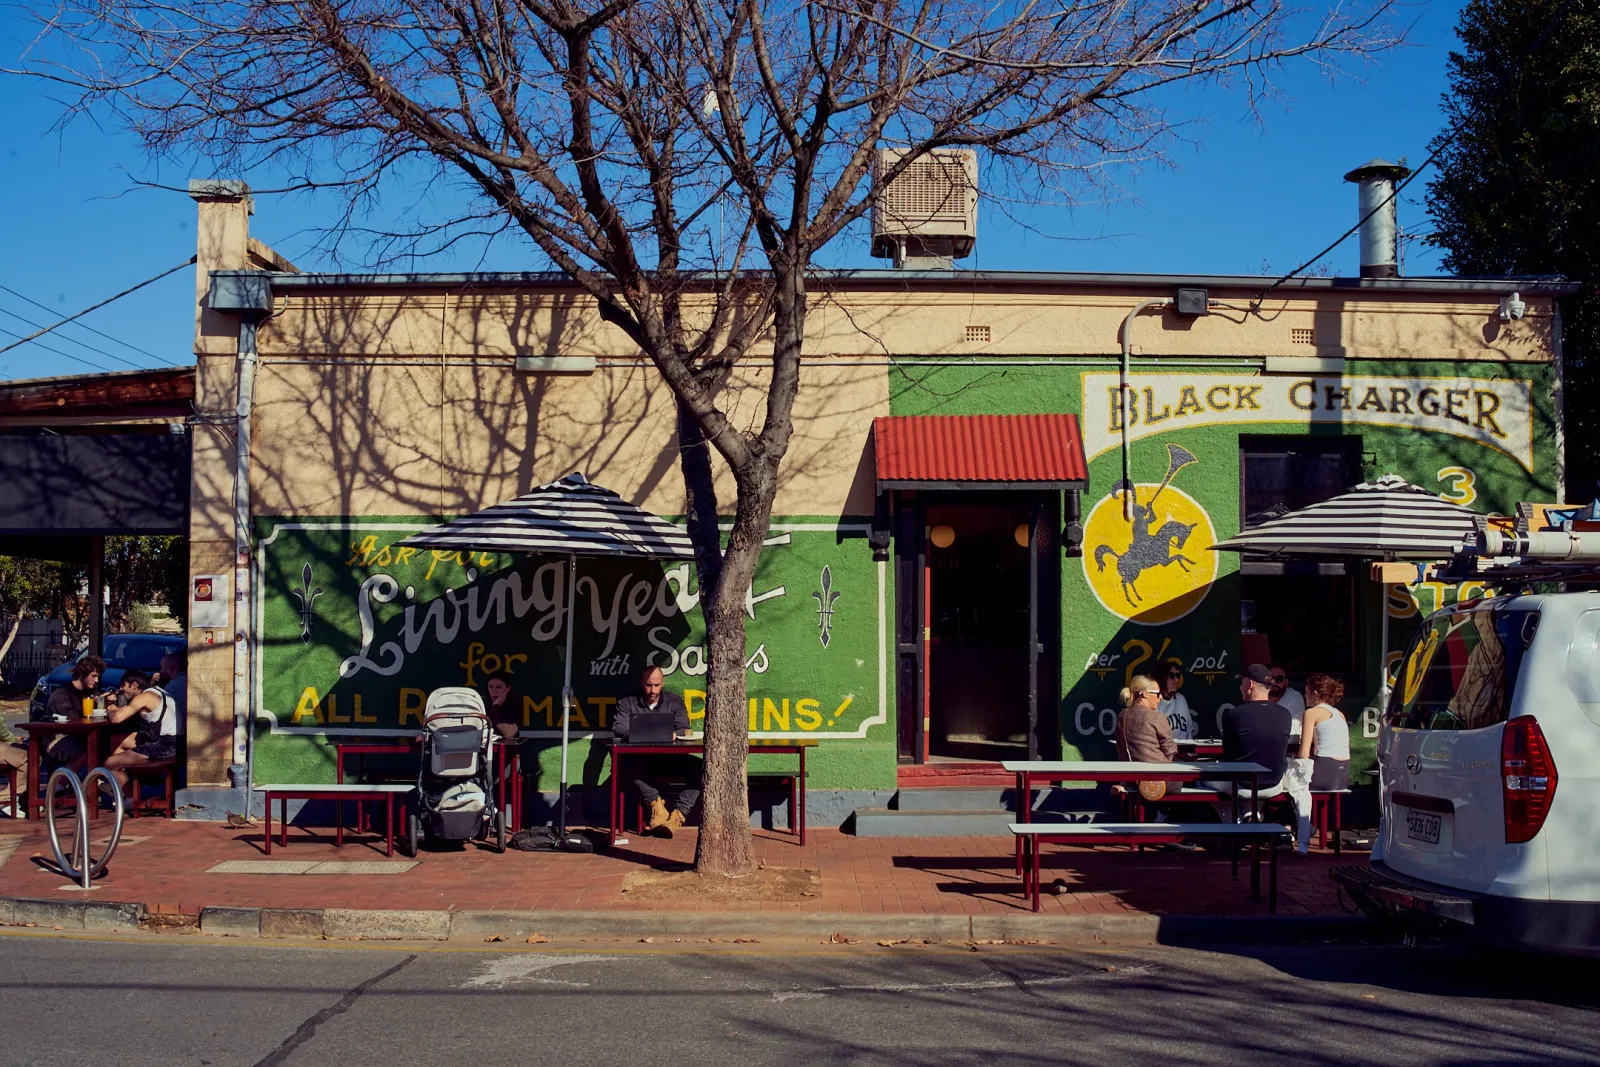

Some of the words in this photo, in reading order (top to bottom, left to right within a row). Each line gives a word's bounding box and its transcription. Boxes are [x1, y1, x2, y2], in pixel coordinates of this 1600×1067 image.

[1107, 383, 1263, 433] BLACK
[1288, 378, 1508, 439] CHARGER
[1437, 466, 1476, 505] 3
[339, 560, 569, 678] Living
[459, 642, 528, 687] for
[589, 653, 630, 677] with
[646, 626, 770, 677] Sas
[1084, 652, 1121, 671] per
[1189, 650, 1229, 673] pot
[290, 686, 377, 725] ALL
[683, 689, 853, 731] PINS!
